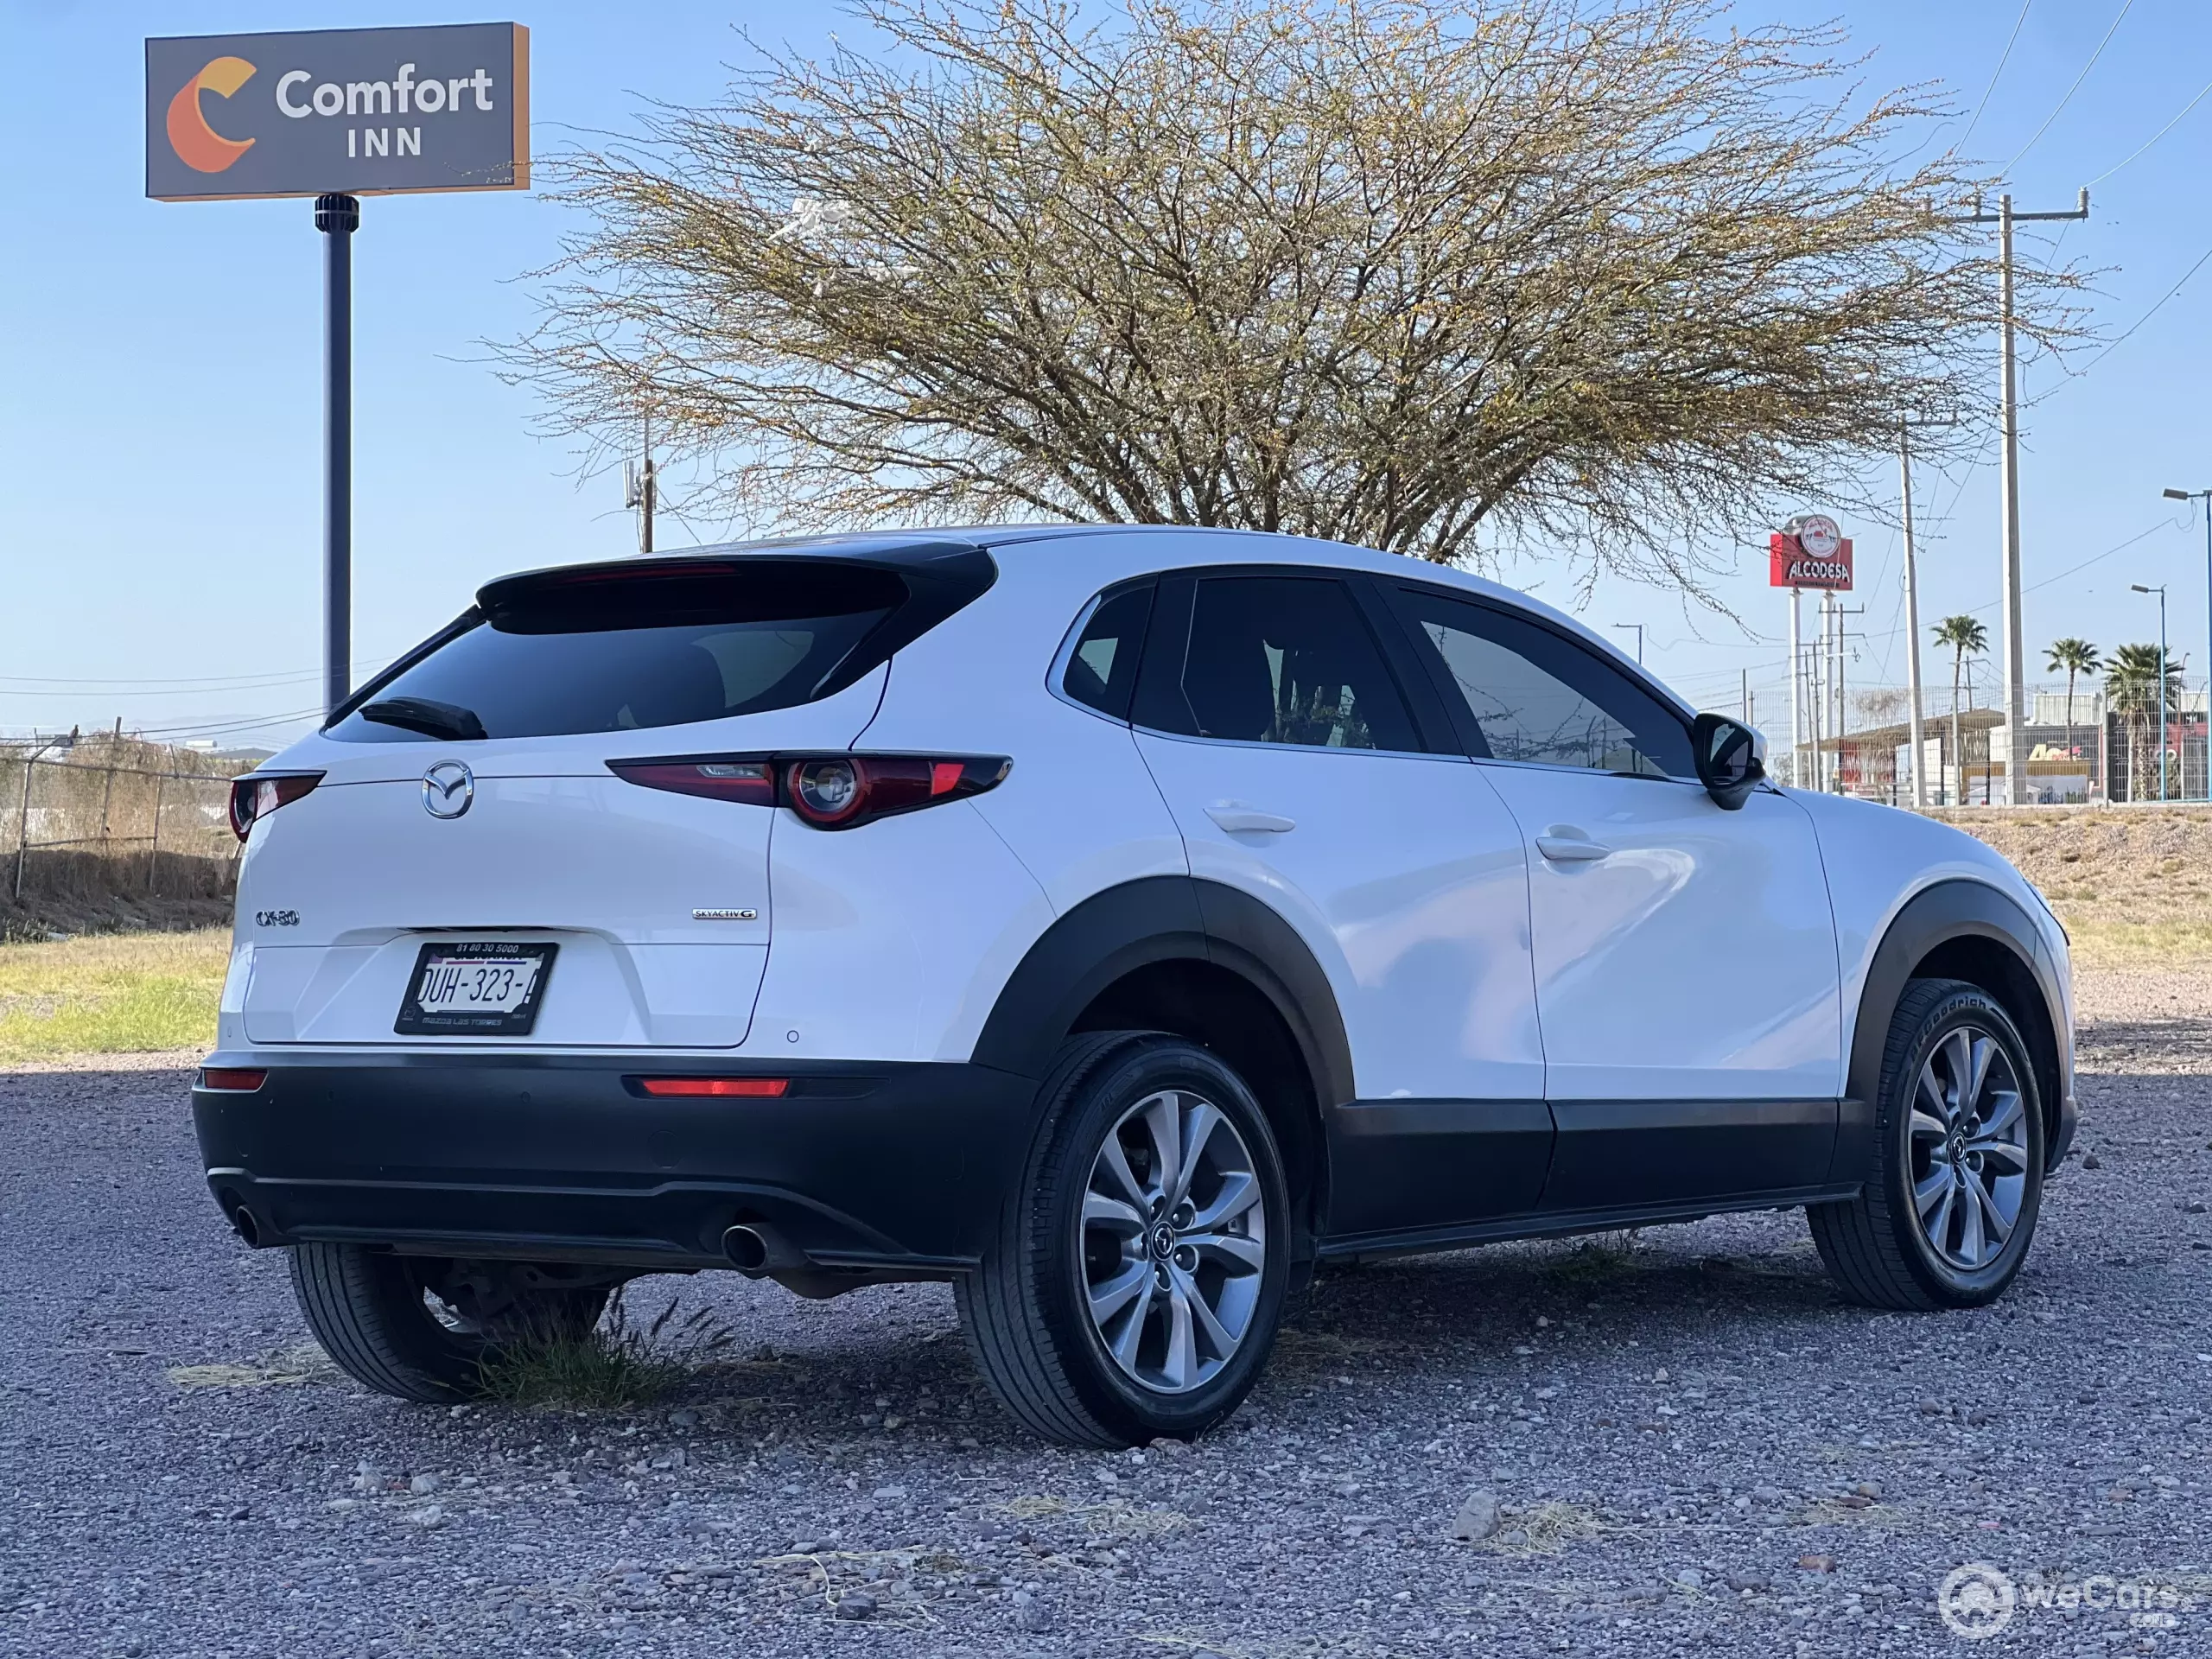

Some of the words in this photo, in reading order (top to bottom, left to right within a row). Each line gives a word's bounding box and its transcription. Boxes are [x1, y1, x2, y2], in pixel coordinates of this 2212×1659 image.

[276, 63, 493, 118] Comfort
[348, 126, 422, 158] INN
[1789, 560, 1851, 583] ALCODESA
[256, 910, 301, 927] CX-30
[496, 944, 519, 953] 5000
